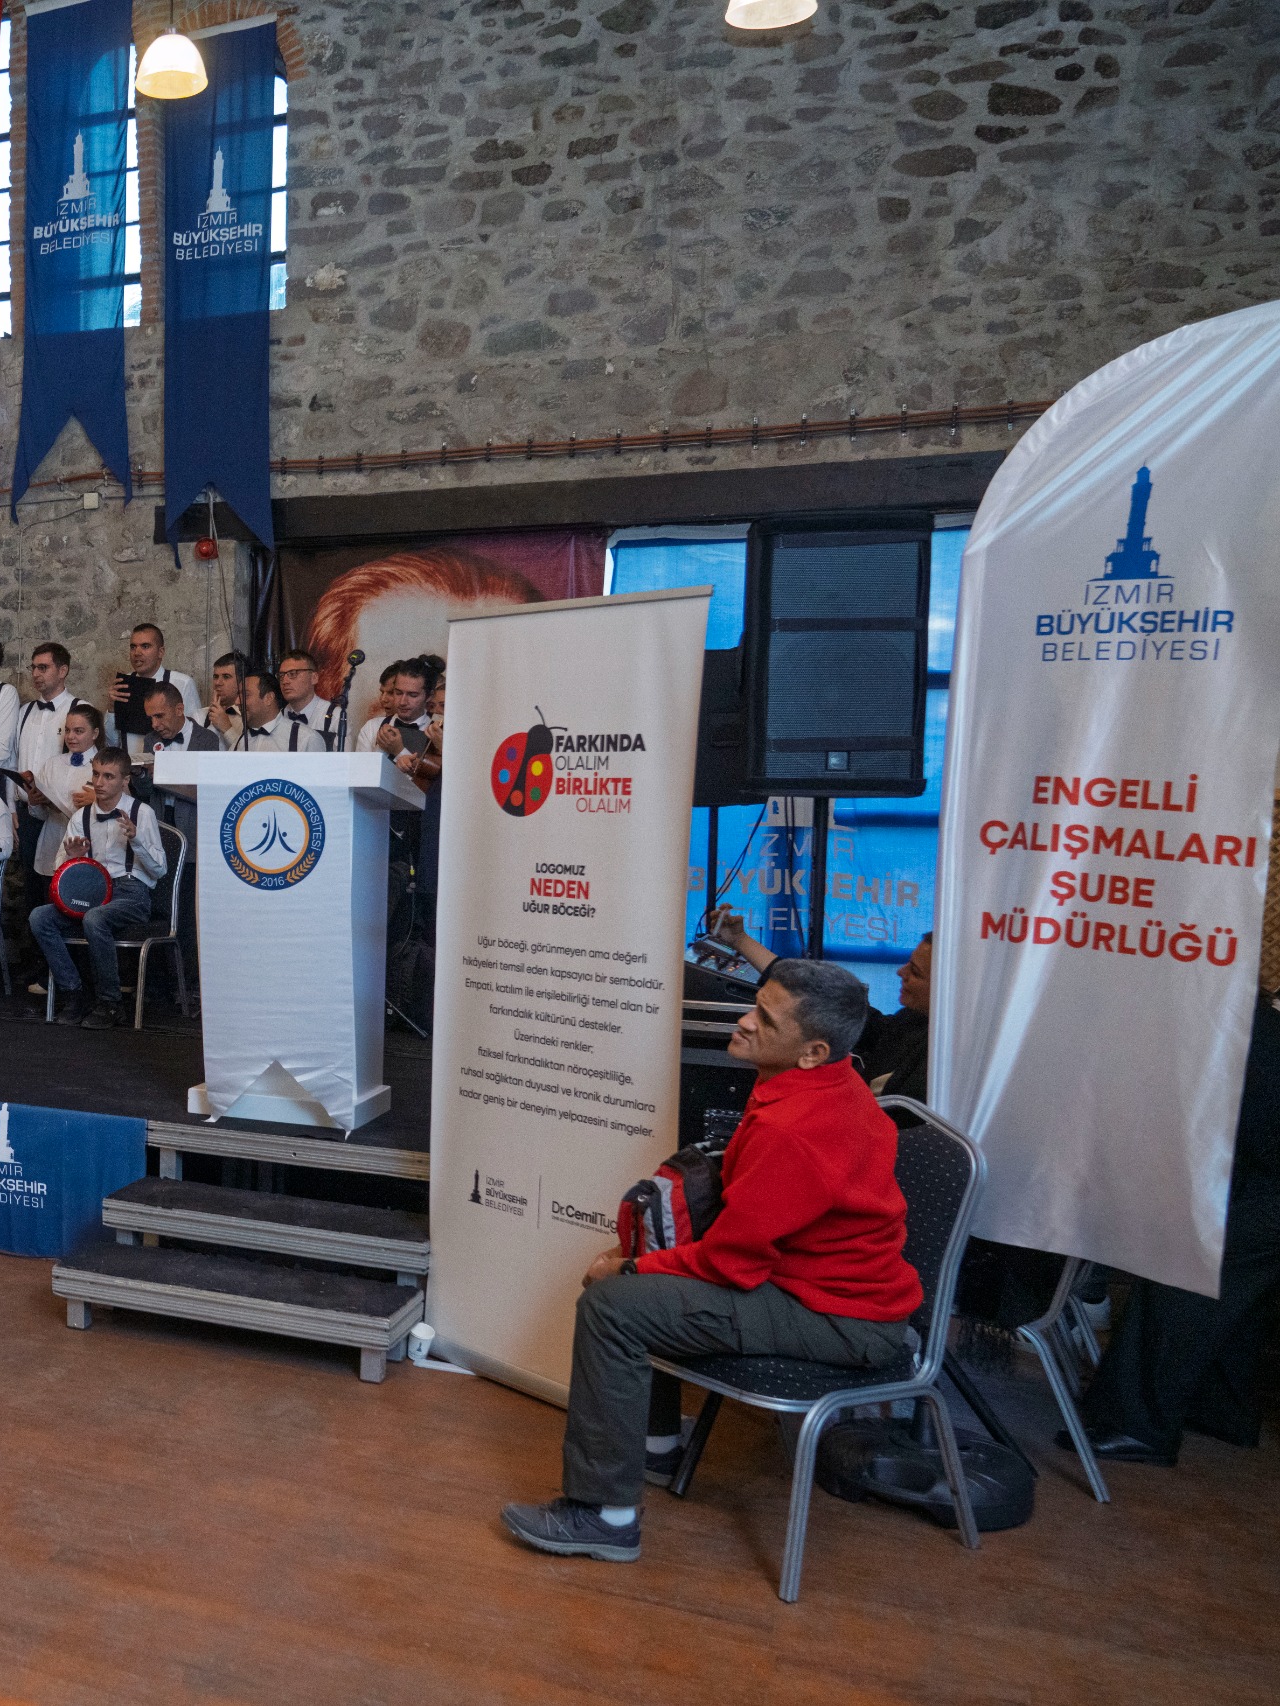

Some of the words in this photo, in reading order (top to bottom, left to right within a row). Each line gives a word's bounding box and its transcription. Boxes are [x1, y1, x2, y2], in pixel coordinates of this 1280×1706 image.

[56, 198, 96, 216] İZMİR
[34, 212, 119, 239] BÜYÜKŞEHİR
[198, 212, 237, 228] İZMİR
[41, 231, 113, 254] BELEDİYESİ
[174, 222, 262, 246] BÜYÜKŞEHİR
[176, 239, 257, 260] BELEDİYESİ
[1084, 582, 1174, 605] İZMİR
[1036, 607, 1234, 636] BÜYÜKŞEHİR
[1042, 638, 1220, 661] BELEDİYESİ
[555, 733, 646, 752] FARKINDA
[555, 756, 608, 770] OLALIM
[555, 772, 632, 795] BİRLİKTE
[1032, 774, 1198, 812] ENGELLİ
[227, 782, 282, 821] DEMOKRASİ
[576, 798, 630, 813] OLALIM
[284, 784, 322, 852] ÜNİVERSİTESİ
[222, 823, 233, 854] İZMİR
[980, 820, 1256, 867] ÇALIŞMALARI
[260, 876, 284, 886] 2016
[536, 863, 585, 876] LOGOMUZ
[530, 878, 589, 900] NEDEN
[1050, 871, 1155, 908] ŞUBE
[522, 900, 549, 914] UĞUR
[552, 904, 596, 918] BÖCEĞİ?
[980, 906, 1237, 966] MÜDÜRLÜĞÜ
[478, 936, 496, 949] Uğur
[531, 942, 586, 957] görünmeyen
[588, 950, 609, 960] ama
[612, 951, 647, 965] değerli
[500, 960, 524, 972] temsil
[526, 964, 548, 976] eden
[550, 967, 593, 982] kapsayıcı
[595, 972, 607, 983] bir
[609, 974, 665, 991] semboldür.
[465, 979, 493, 992] Empati,
[496, 982, 522, 995] katılım
[525, 987, 534, 997] ile
[536, 989, 590, 1007] erişilebilirliği
[592, 997, 618, 1009] temel
[620, 999, 642, 1012] alan
[646, 1004, 659, 1014] bir
[490, 1004, 533, 1020] farkındalık
[535, 1010, 576, 1027] kültürünü
[578, 1018, 622, 1034] destekler.
[514, 1028, 558, 1047] Üzerindeki
[478, 1046, 504, 1060] fiziksel
[505, 1052, 565, 1071] farkındalıktan
[460, 1066, 484, 1079] ruhsal
[486, 1070, 523, 1087] sağlıktan
[525, 1078, 559, 1094] duyusal
[561, 1087, 572, 1096] ve
[574, 1088, 601, 1102] kronik
[603, 1094, 655, 1113] durumlara
[459, 1087, 481, 1100] kadar
[483, 1092, 505, 1106] geniş
[507, 1097, 518, 1108] bir
[520, 1100, 556, 1117] deneyim
[558, 1109, 608, 1128] yelpazesini
[610, 1121, 655, 1138] simgeler.
[486, 1187, 527, 1206] BÜYÜKŞEHİR
